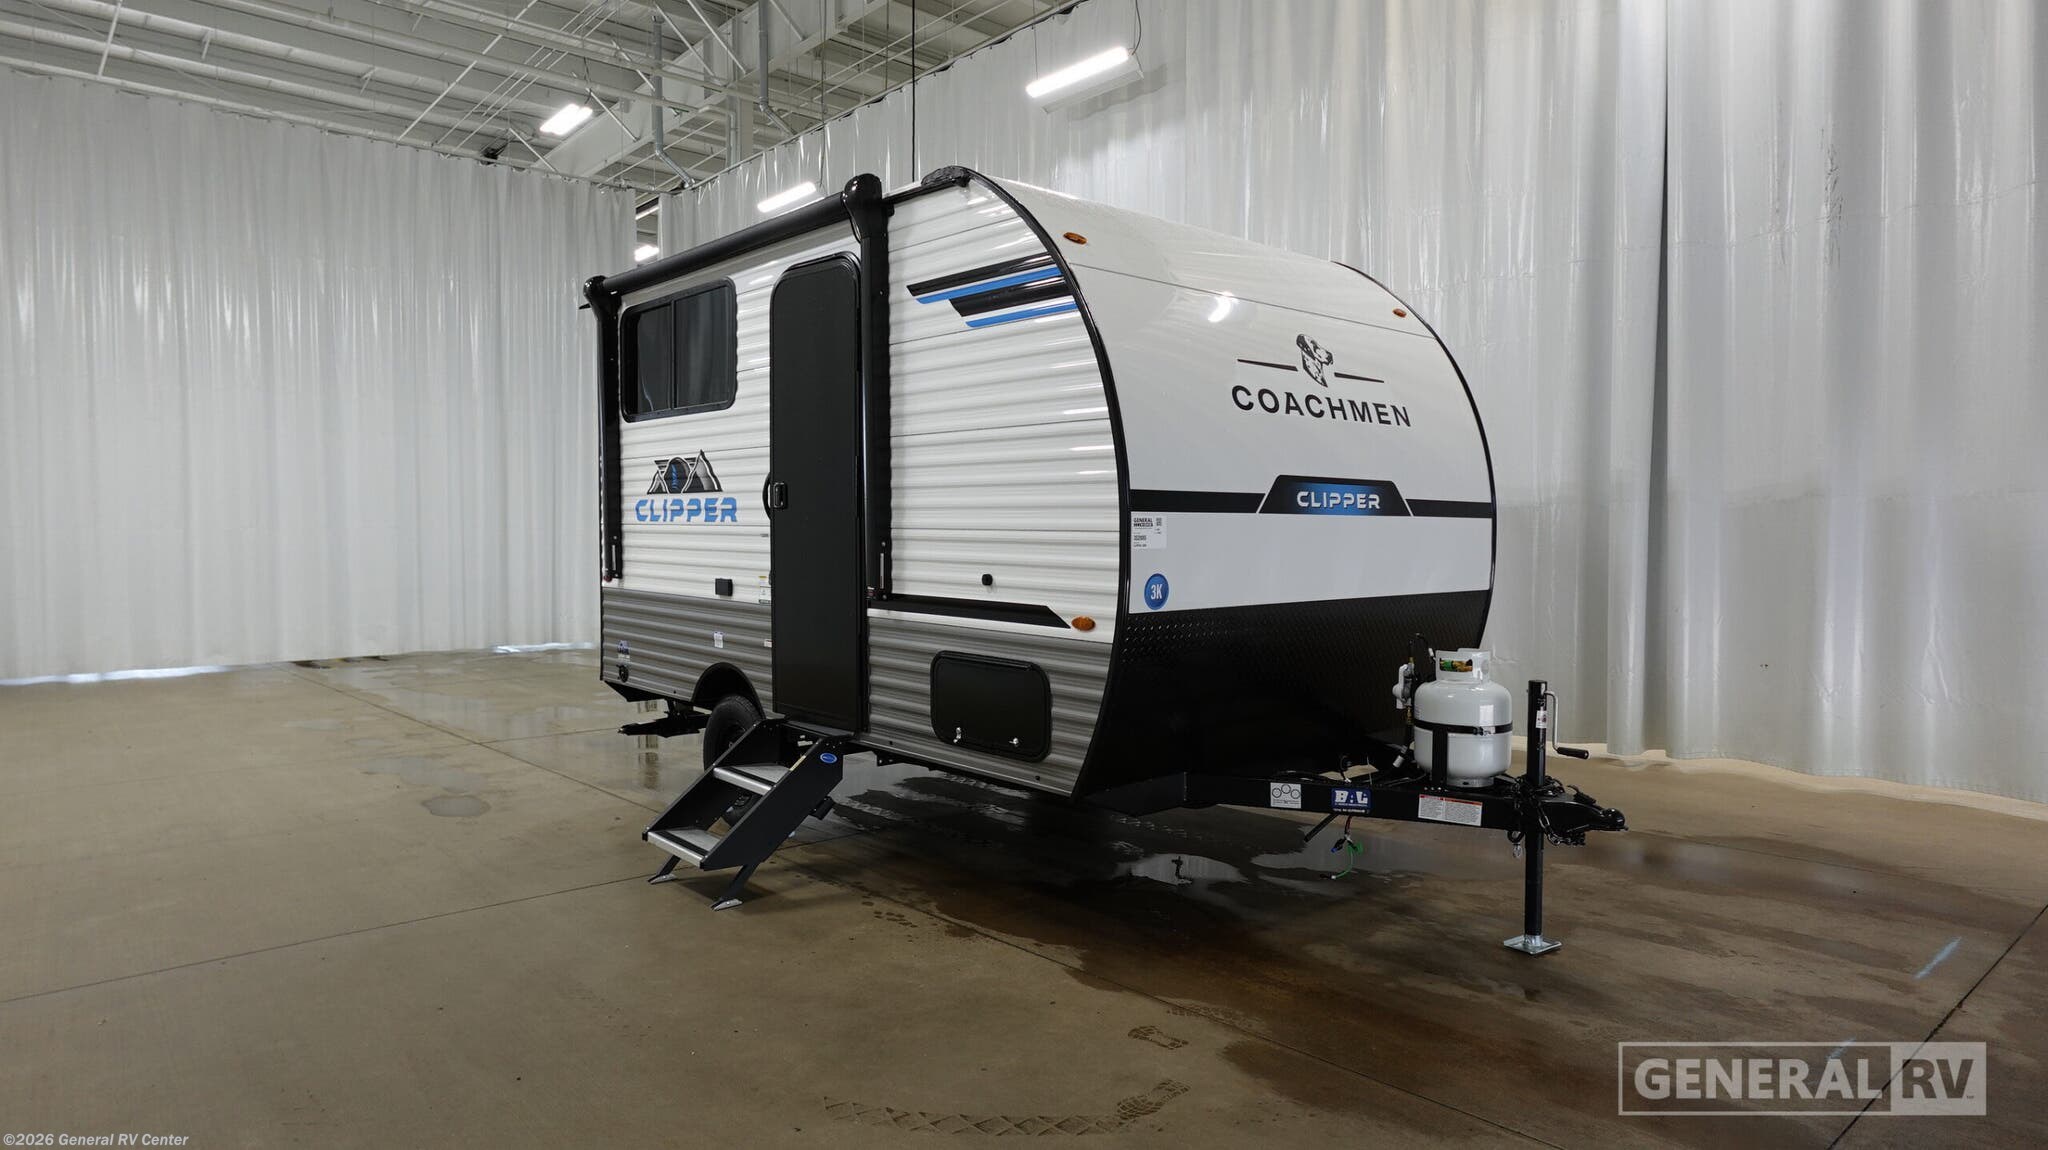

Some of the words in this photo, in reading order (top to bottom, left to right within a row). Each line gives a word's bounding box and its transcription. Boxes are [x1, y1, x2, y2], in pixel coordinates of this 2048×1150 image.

[1231, 385, 1411, 427] COACHMEN
[635, 497, 738, 522] CLIPPER
[1296, 491, 1381, 509] CLIPPER
[1150, 584, 1163, 600] 3K
